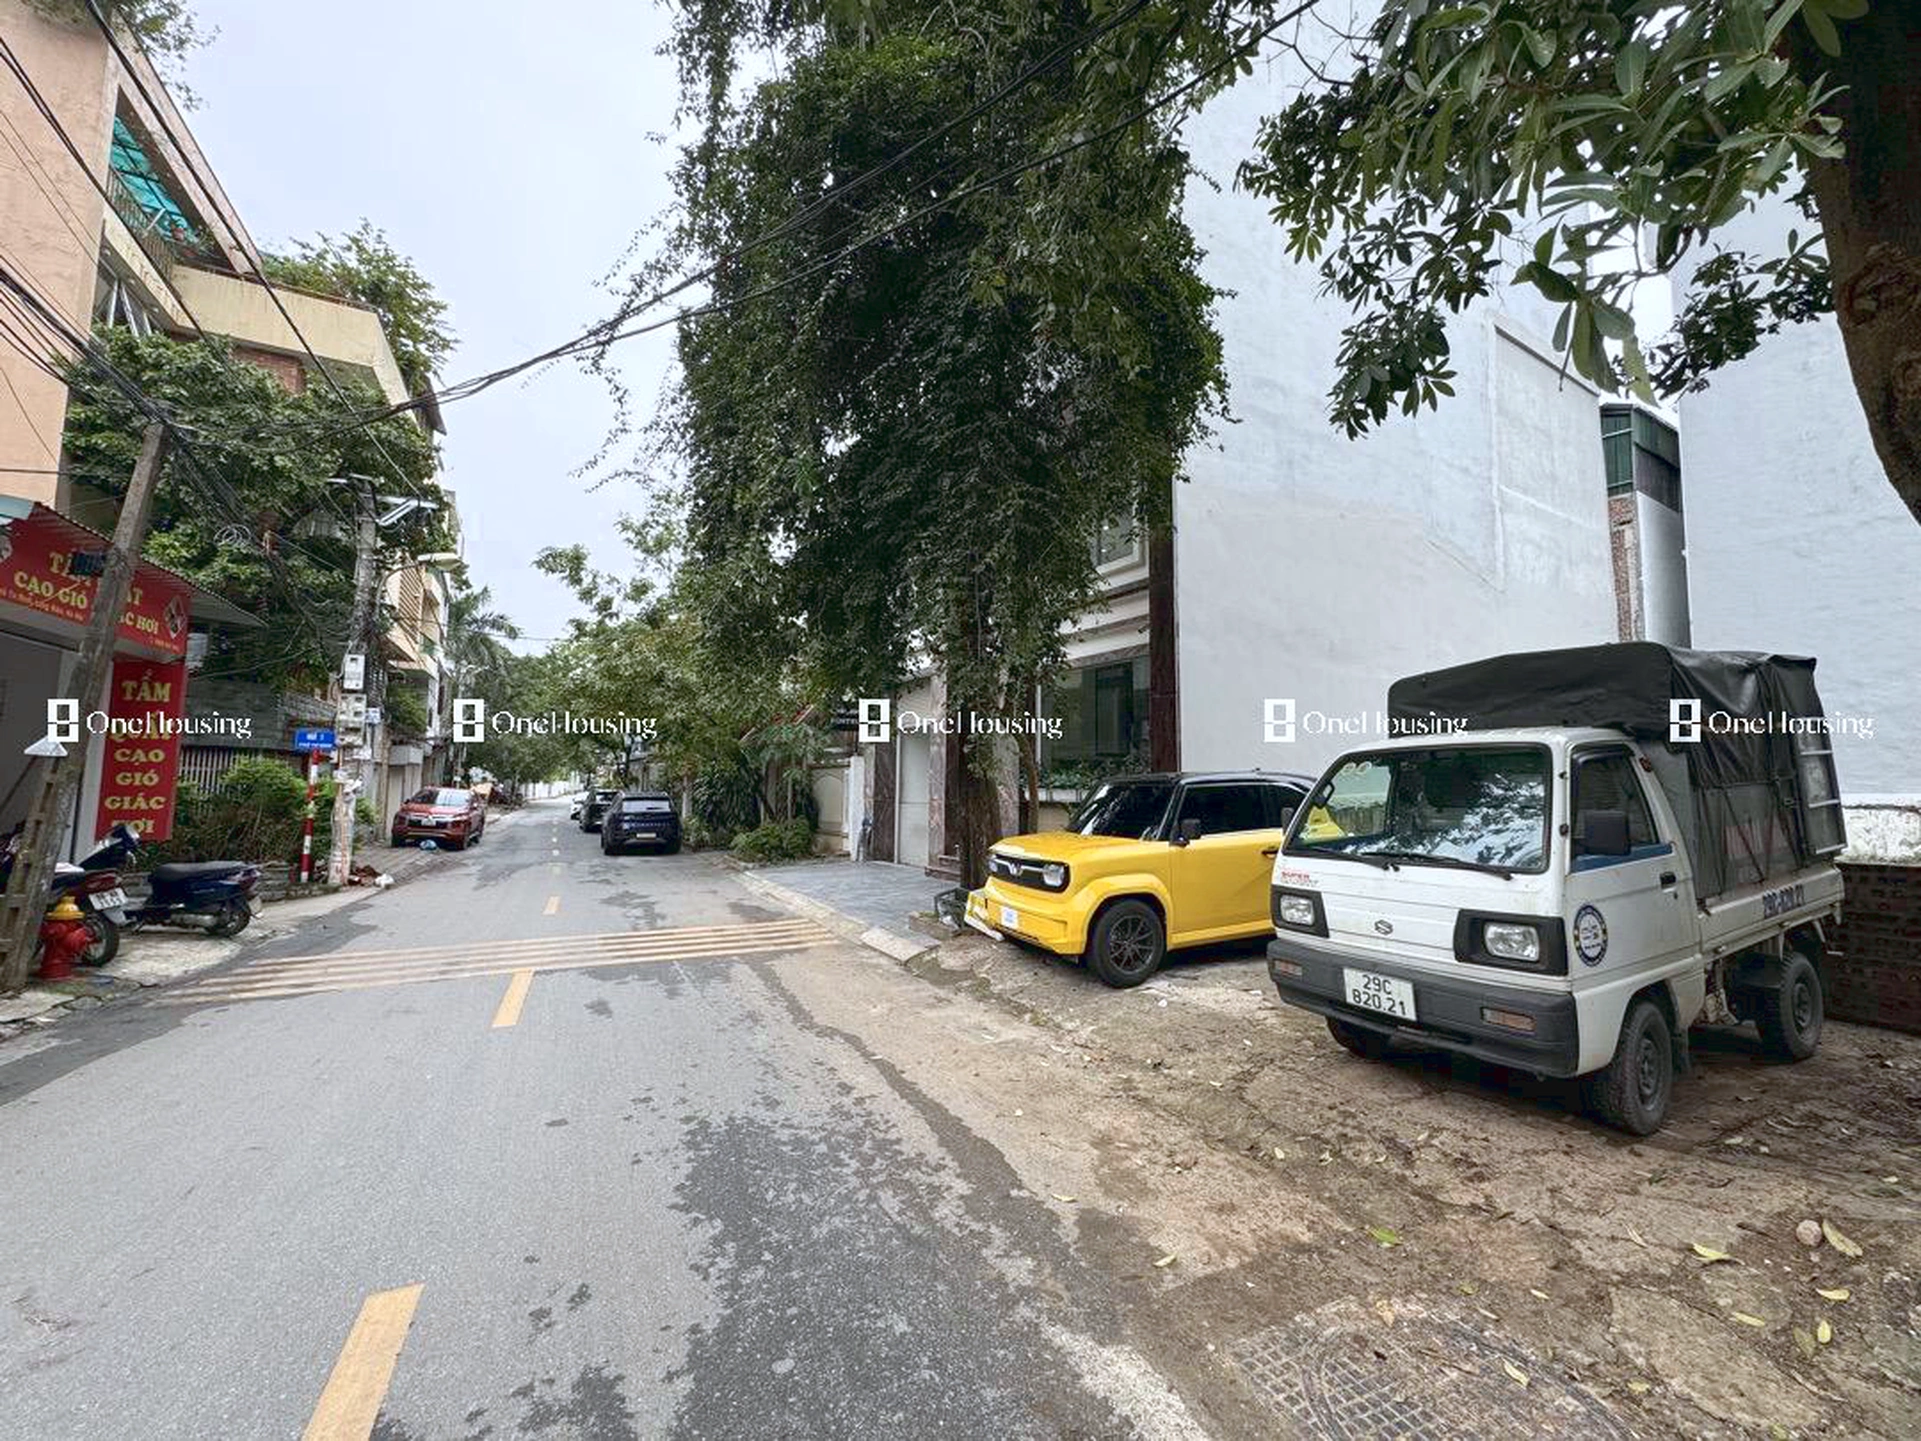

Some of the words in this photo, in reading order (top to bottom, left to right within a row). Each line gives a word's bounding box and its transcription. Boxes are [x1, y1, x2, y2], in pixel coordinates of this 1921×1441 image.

[58, 588, 88, 610] GIÓ
[114, 748, 165, 766] CẠO
[115, 768, 160, 786] GIÓ
[104, 792, 167, 810] GIÁC
[1362, 974, 1392, 995] 29C
[1352, 988, 1406, 1016] 820.21
